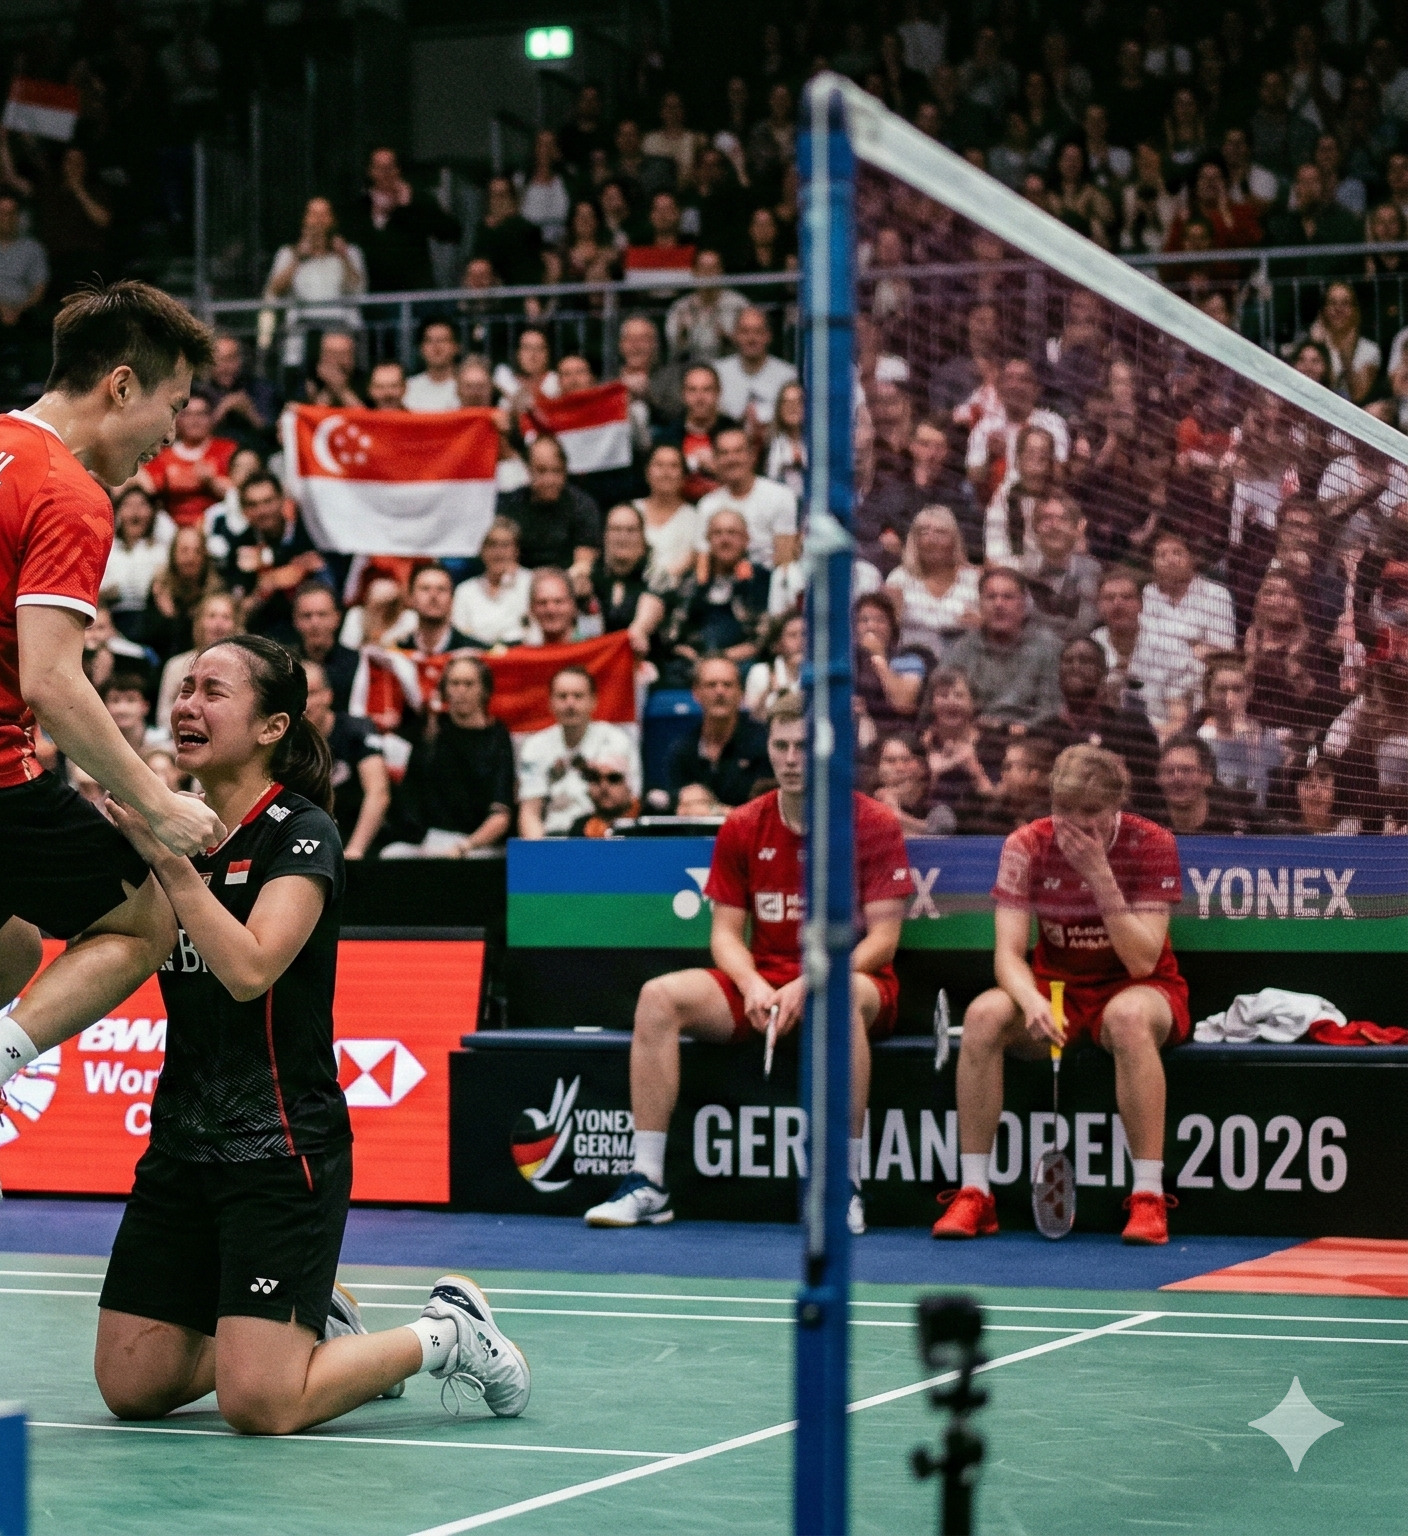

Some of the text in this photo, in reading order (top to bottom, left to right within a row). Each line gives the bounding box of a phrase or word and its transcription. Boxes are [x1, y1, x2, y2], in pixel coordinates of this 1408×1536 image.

[1187, 866, 1357, 920] YONEX
[78, 1017, 167, 1052] BW
[83, 1060, 165, 1094] Wor
[574, 1109, 635, 1132] YONEX
[693, 1104, 958, 1182] GERAN
[1176, 1113, 1348, 1193] 2026
[573, 1157, 609, 1175] OPEN
